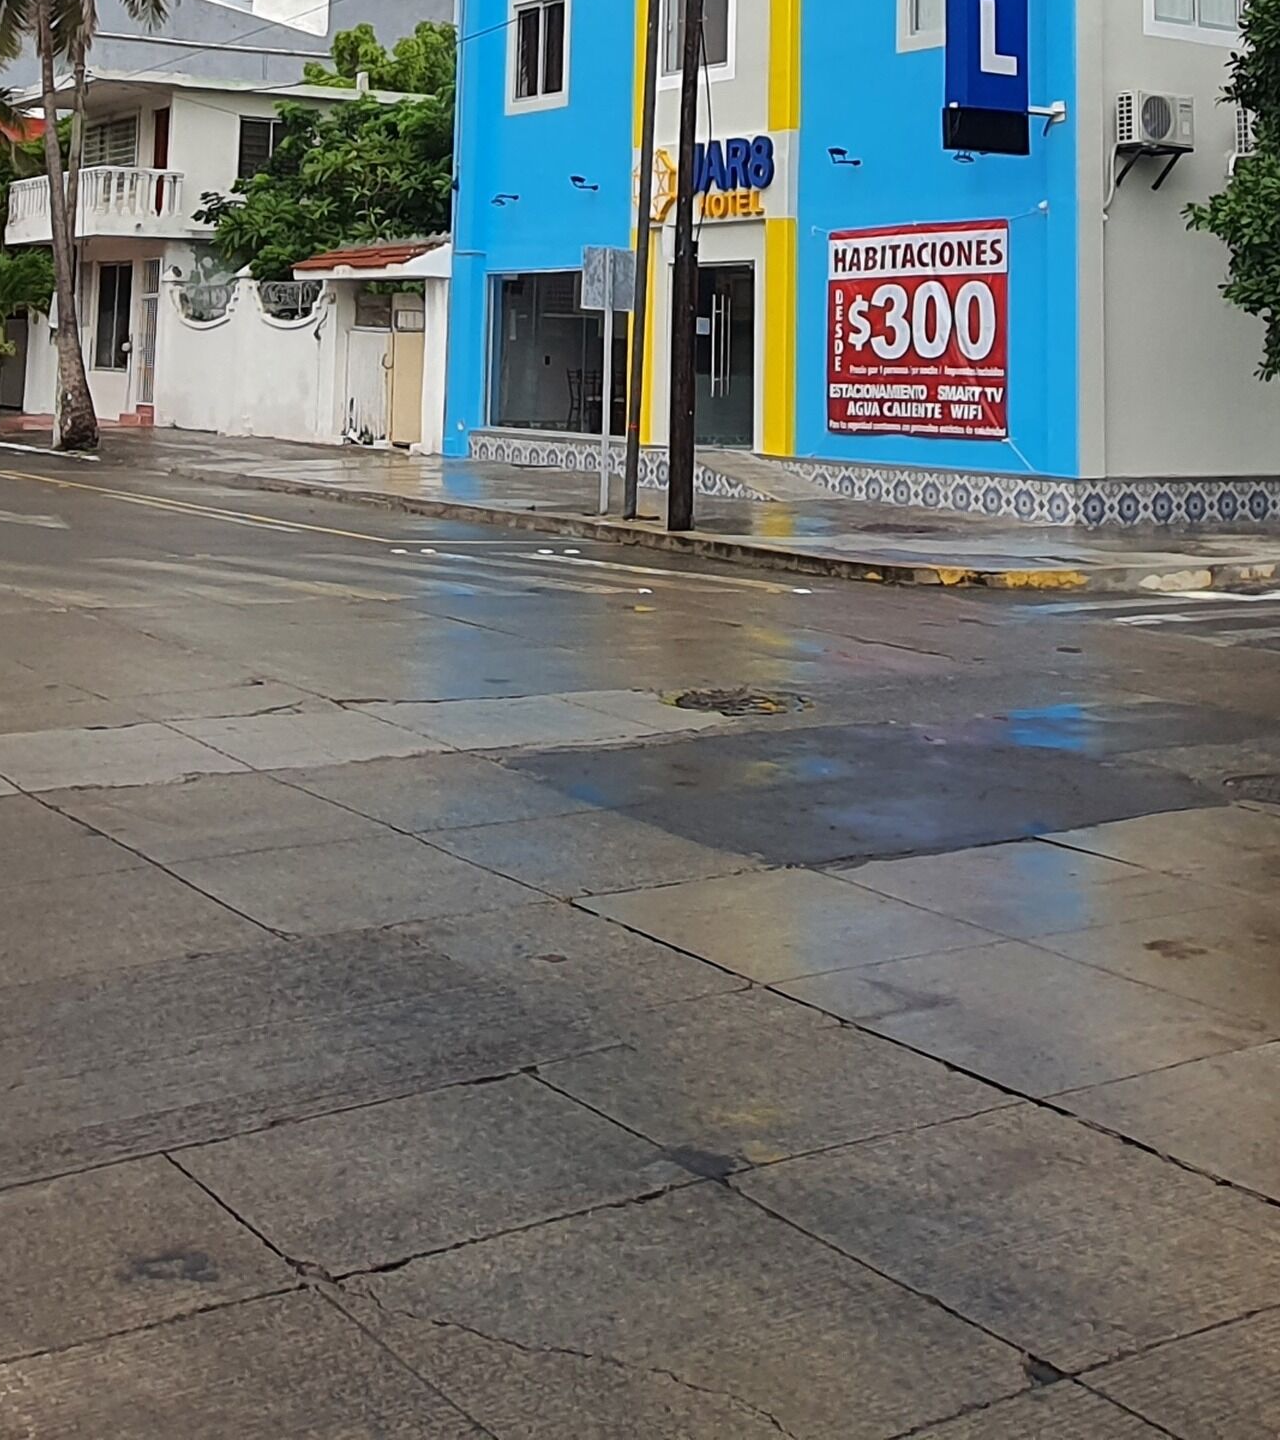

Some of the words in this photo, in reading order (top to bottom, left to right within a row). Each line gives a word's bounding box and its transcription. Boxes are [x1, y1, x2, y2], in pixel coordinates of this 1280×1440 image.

[699, 190, 765, 220] HOTEL
[833, 238, 1004, 273] HABITACIONES
[834, 289, 844, 372] DESDE
[847, 280, 996, 360] $300
[829, 383, 928, 400] ESTACIONAMIENTO
[937, 385, 982, 402] SMART
[984, 387, 1003, 403] TV
[847, 401, 880, 416] AGUA
[882, 402, 942, 419] CALIENTE
[950, 404, 983, 420] WIFI
